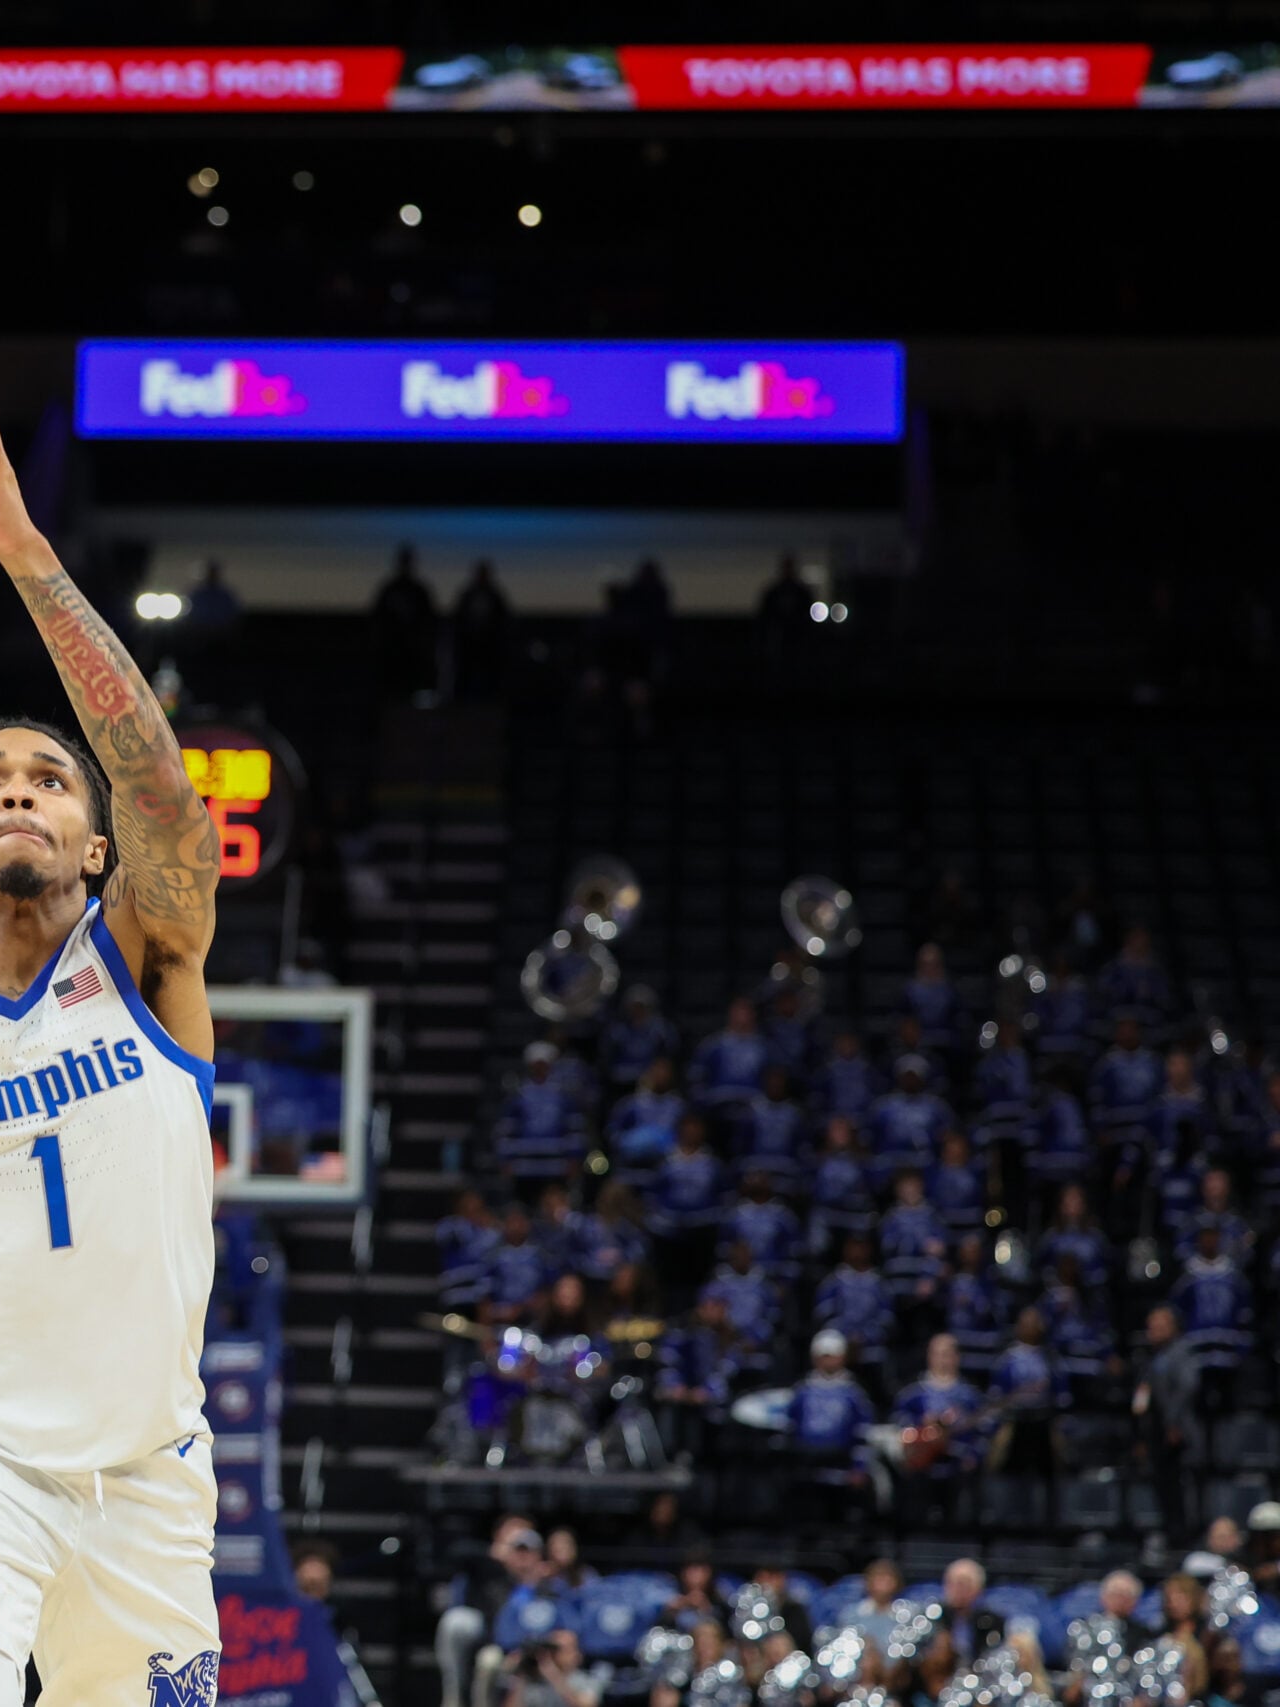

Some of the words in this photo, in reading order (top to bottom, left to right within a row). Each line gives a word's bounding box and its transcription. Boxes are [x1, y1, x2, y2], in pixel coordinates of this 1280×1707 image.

[120, 60, 209, 99] HAS
[213, 59, 343, 99] MORE
[683, 57, 858, 97] TOYOTA
[859, 56, 953, 96] HAS
[957, 56, 1091, 96] MORE
[28, 1133, 73, 1251] 1
